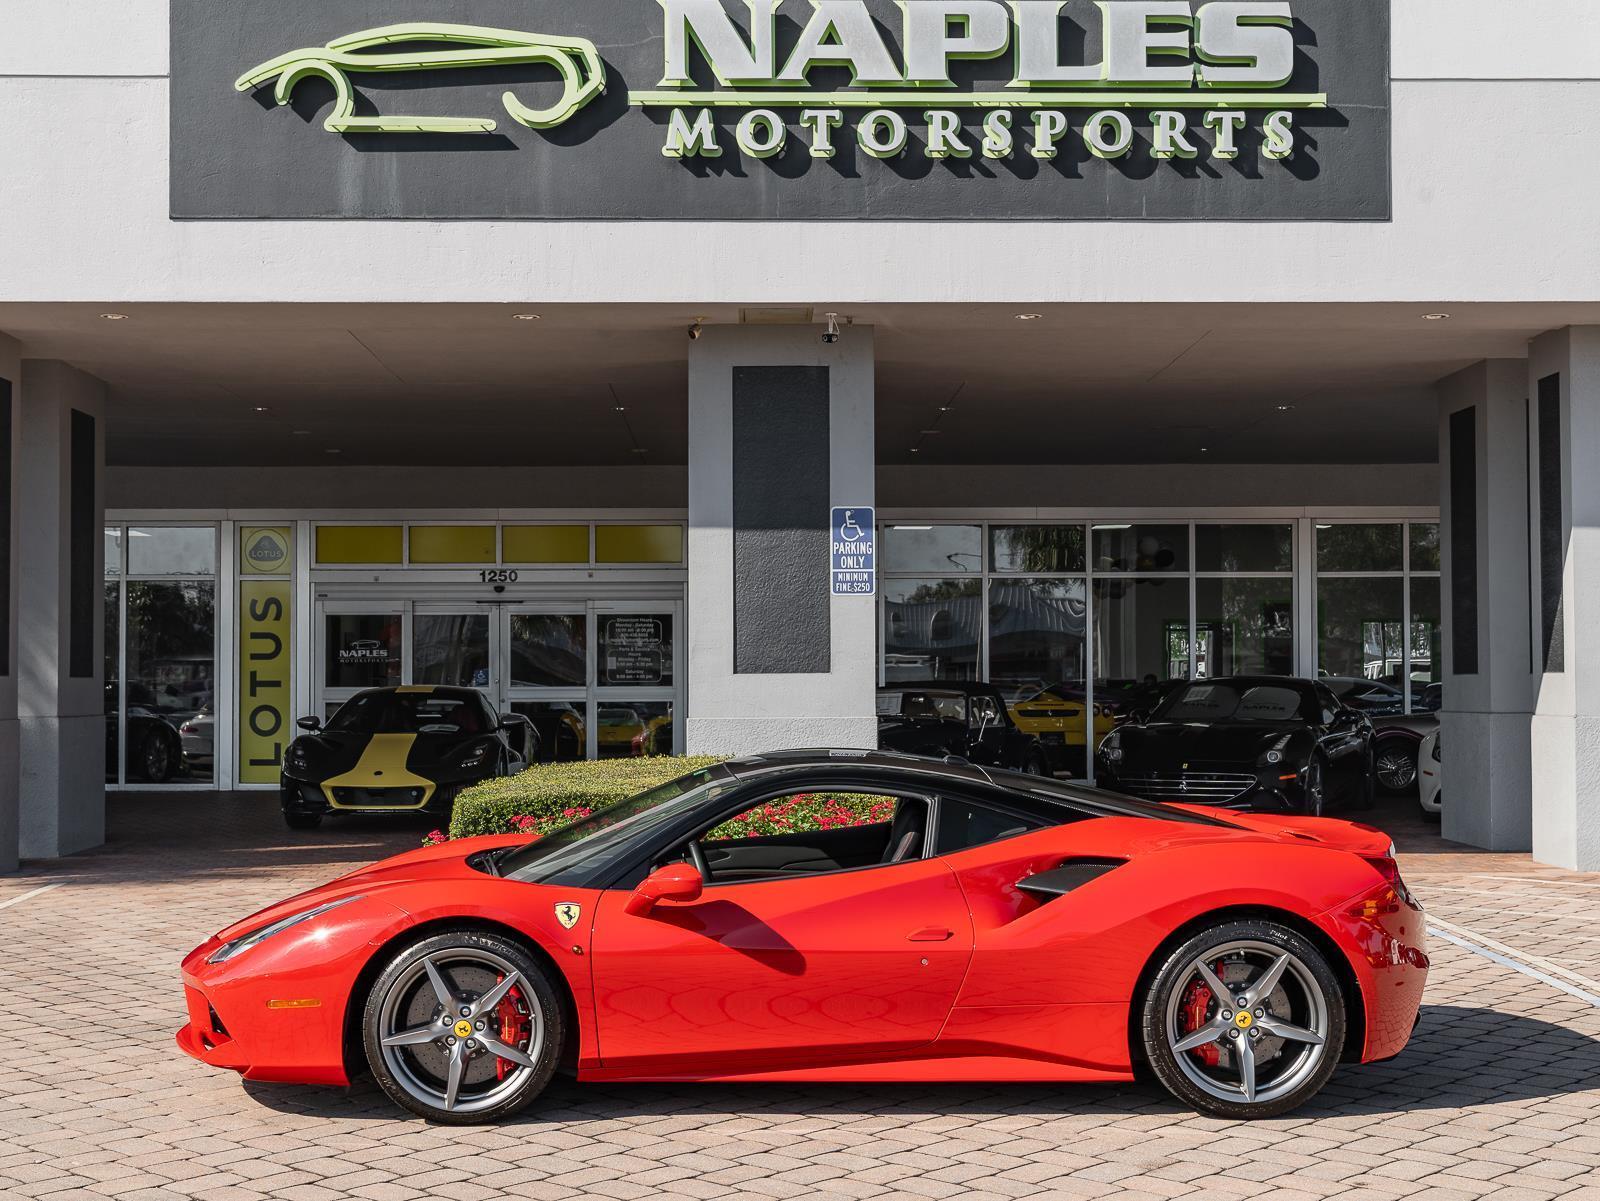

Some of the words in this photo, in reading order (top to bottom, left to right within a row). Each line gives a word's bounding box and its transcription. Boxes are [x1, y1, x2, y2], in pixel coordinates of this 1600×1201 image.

[657, 0, 1295, 86] NAPLES
[663, 108, 1296, 159] MOTORSPORTS
[251, 550, 281, 558] LOTUS
[833, 542, 873, 555] PARKING
[840, 556, 865, 568] ONLY
[479, 570, 518, 583] 1250
[838, 573, 868, 581] MINIMUM
[836, 583, 851, 592] FINE
[854, 582, 870, 592] $250
[339, 649, 388, 657] NAPLES
[249, 597, 283, 767] LOTUS
